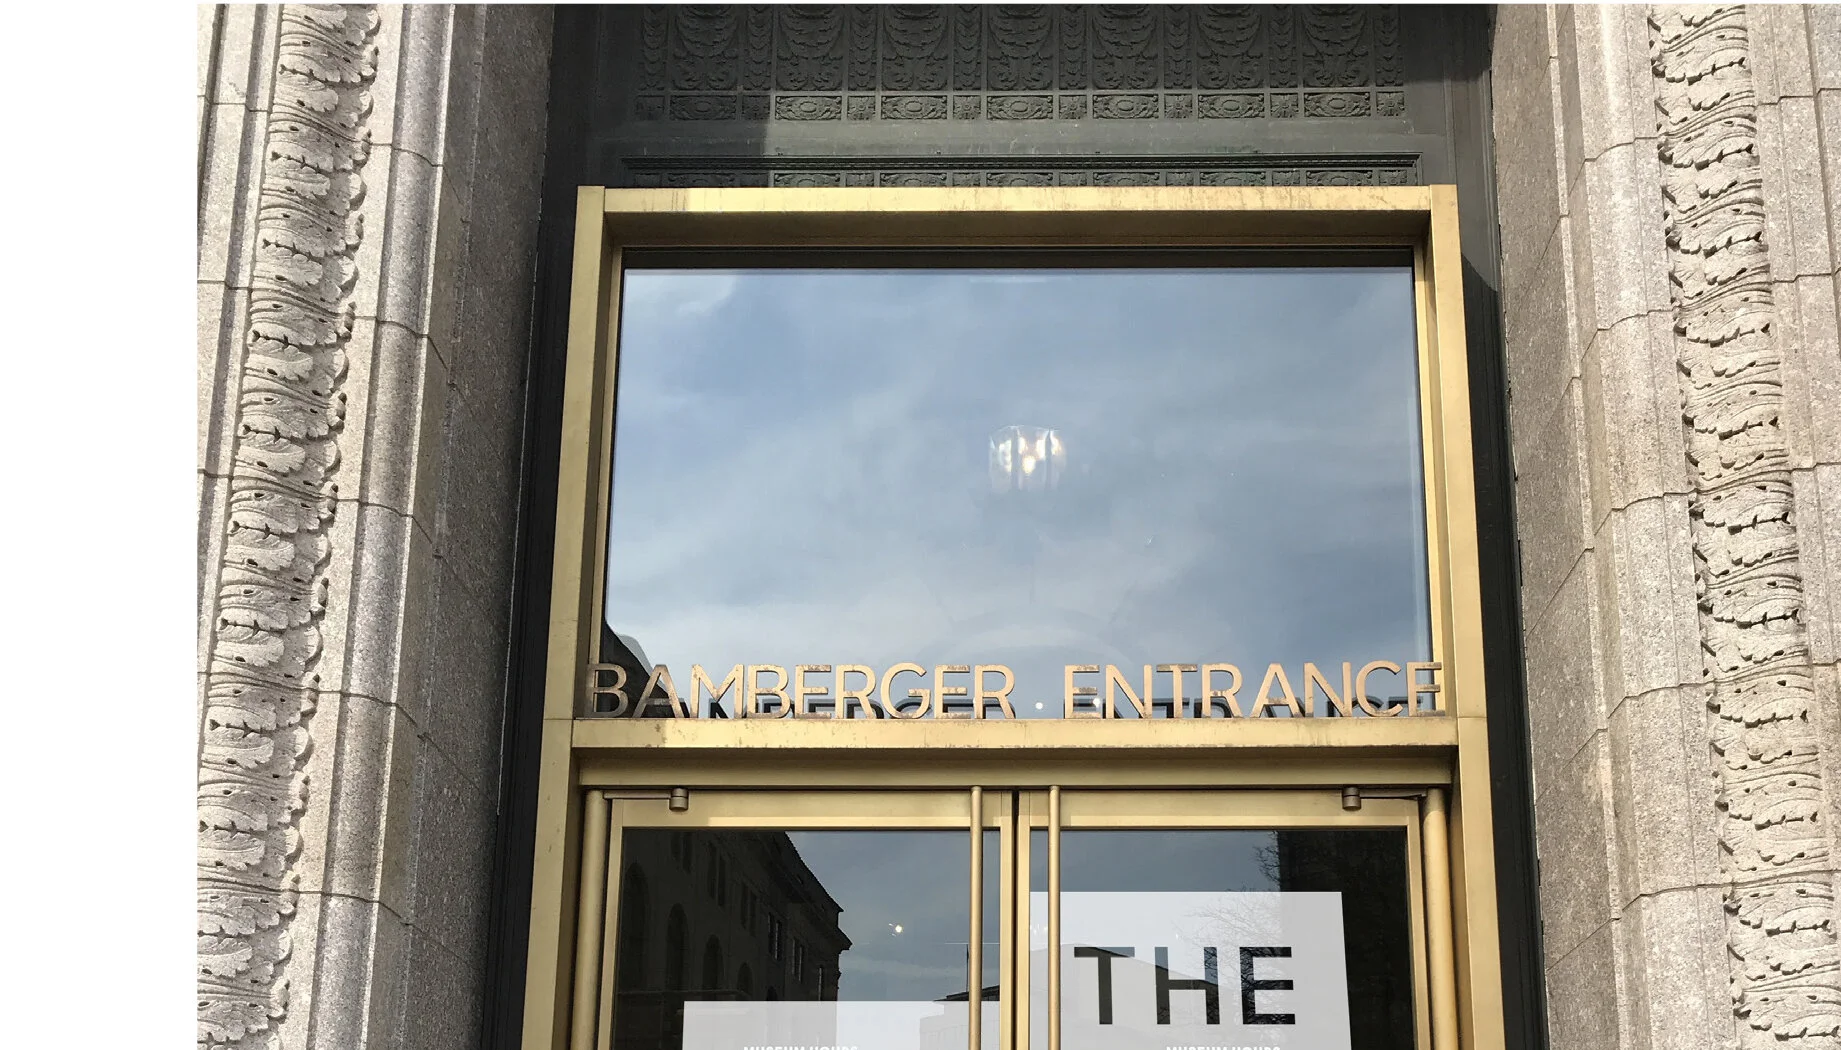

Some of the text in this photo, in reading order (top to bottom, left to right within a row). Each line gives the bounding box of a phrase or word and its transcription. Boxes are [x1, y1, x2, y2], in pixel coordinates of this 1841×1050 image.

[587, 661, 1443, 720] BAMBERGER ENTRANCE
[1073, 946, 1296, 1025] THE
